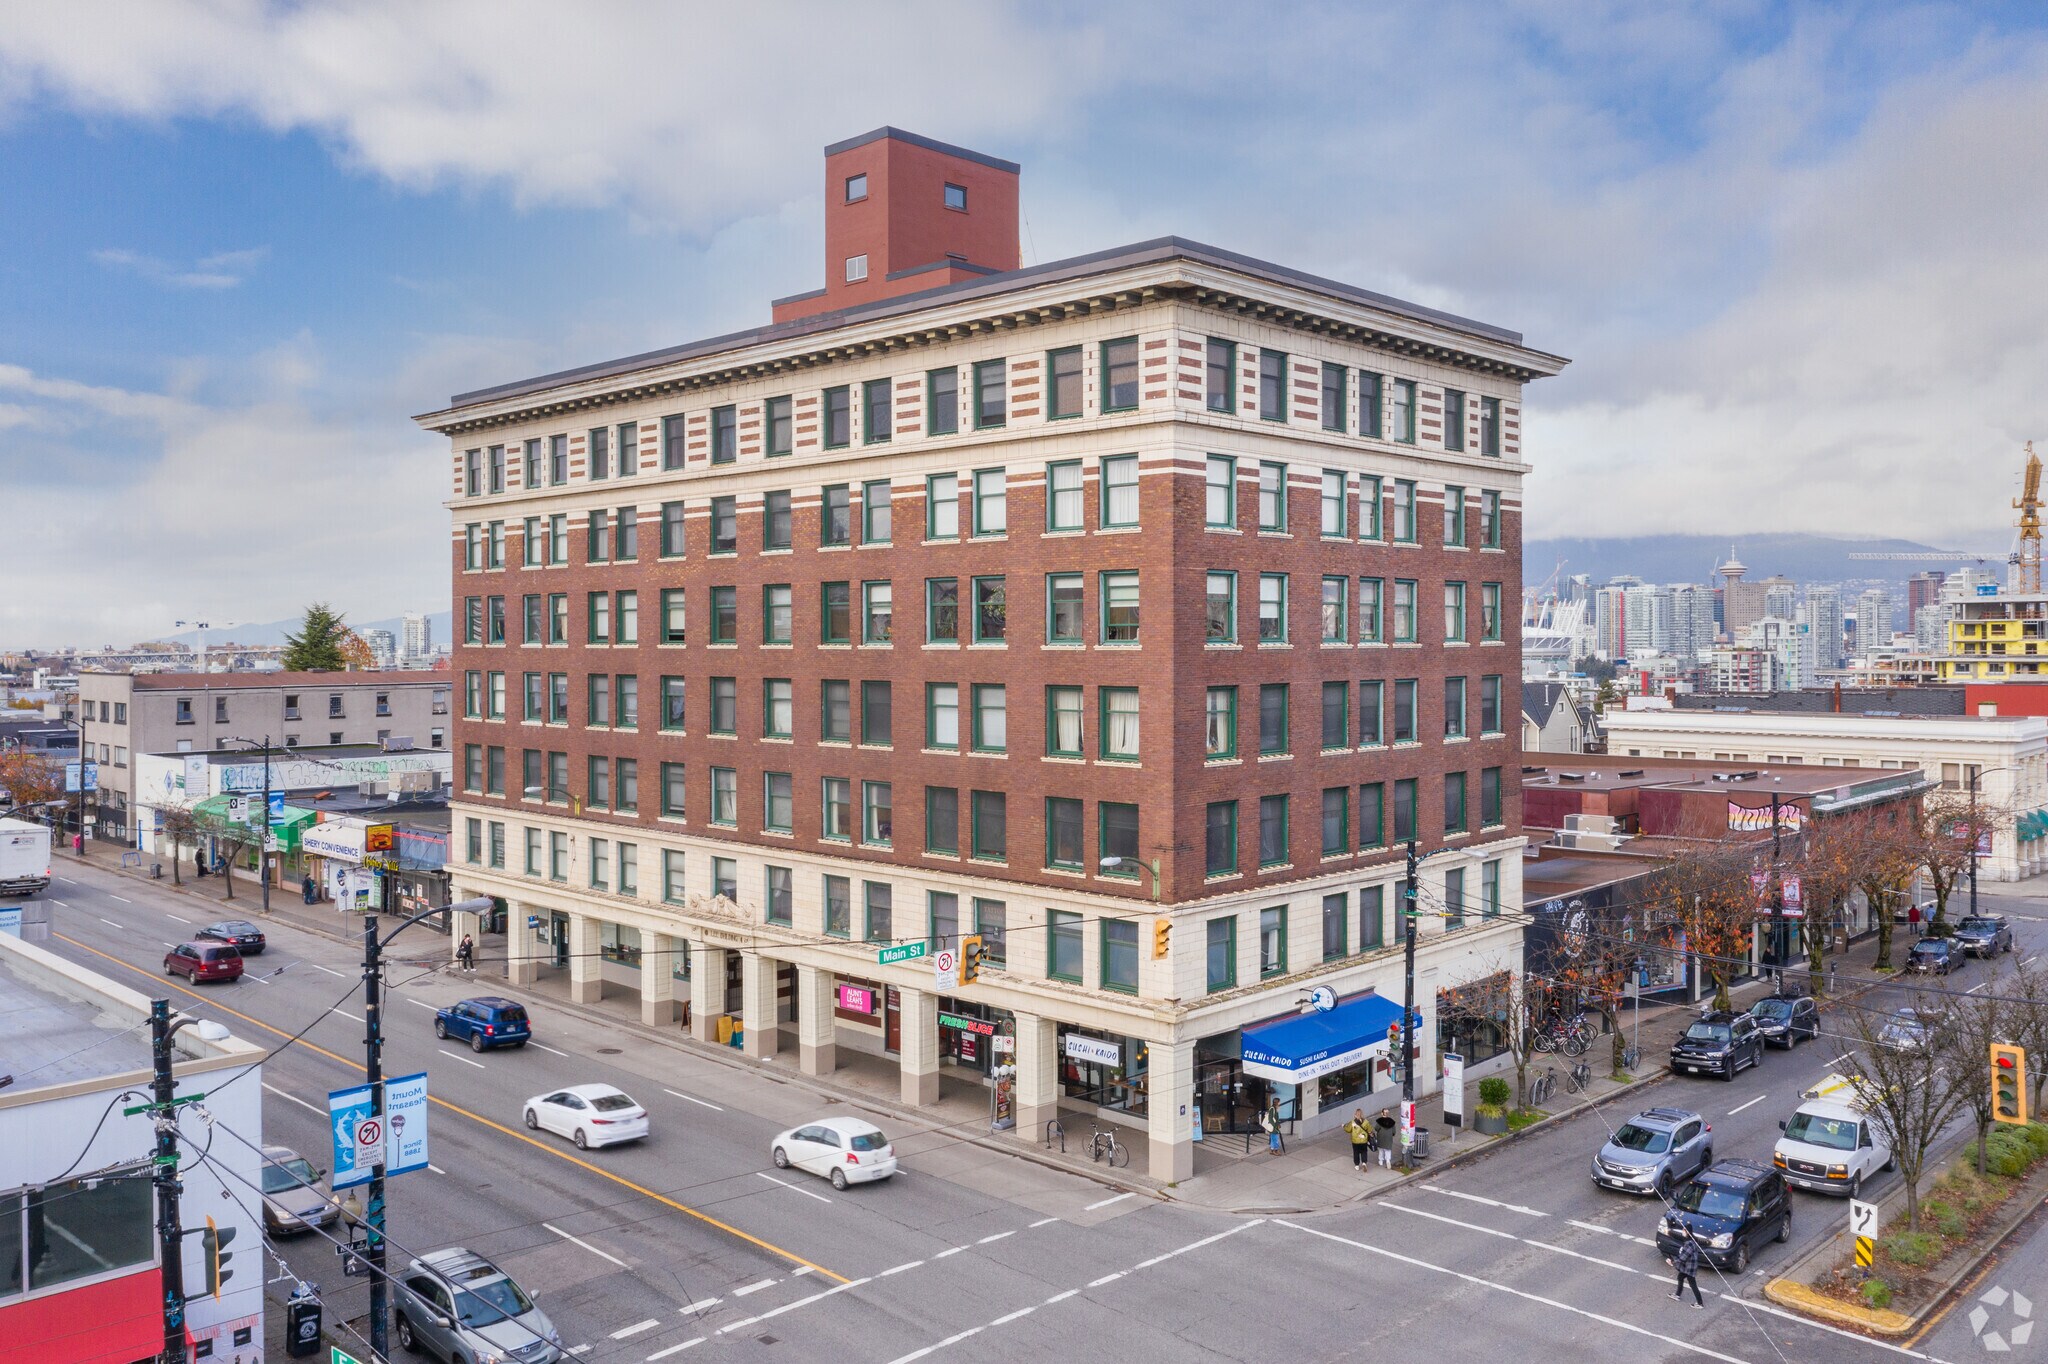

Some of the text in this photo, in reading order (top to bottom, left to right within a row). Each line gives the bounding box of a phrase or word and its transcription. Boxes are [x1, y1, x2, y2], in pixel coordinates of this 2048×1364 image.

[304, 838, 320, 849] SHERY
[321, 841, 359, 858] CONVENIENCE
[883, 945, 921, 962] Main St
[847, 988, 863, 998] AUNT
[939, 1014, 994, 1036] FRESHSLICE
[1068, 1041, 1118, 1060] SUSHI KAIDO
[1243, 1050, 1292, 1067] SUSHI KAIDO
[1299, 1050, 1328, 1066] SUSHI KAIDO
[1298, 1051, 1364, 1079] DINE-IN TAKE OUT DELIVERY
[358, 1152, 382, 1162] EMERGENCY
